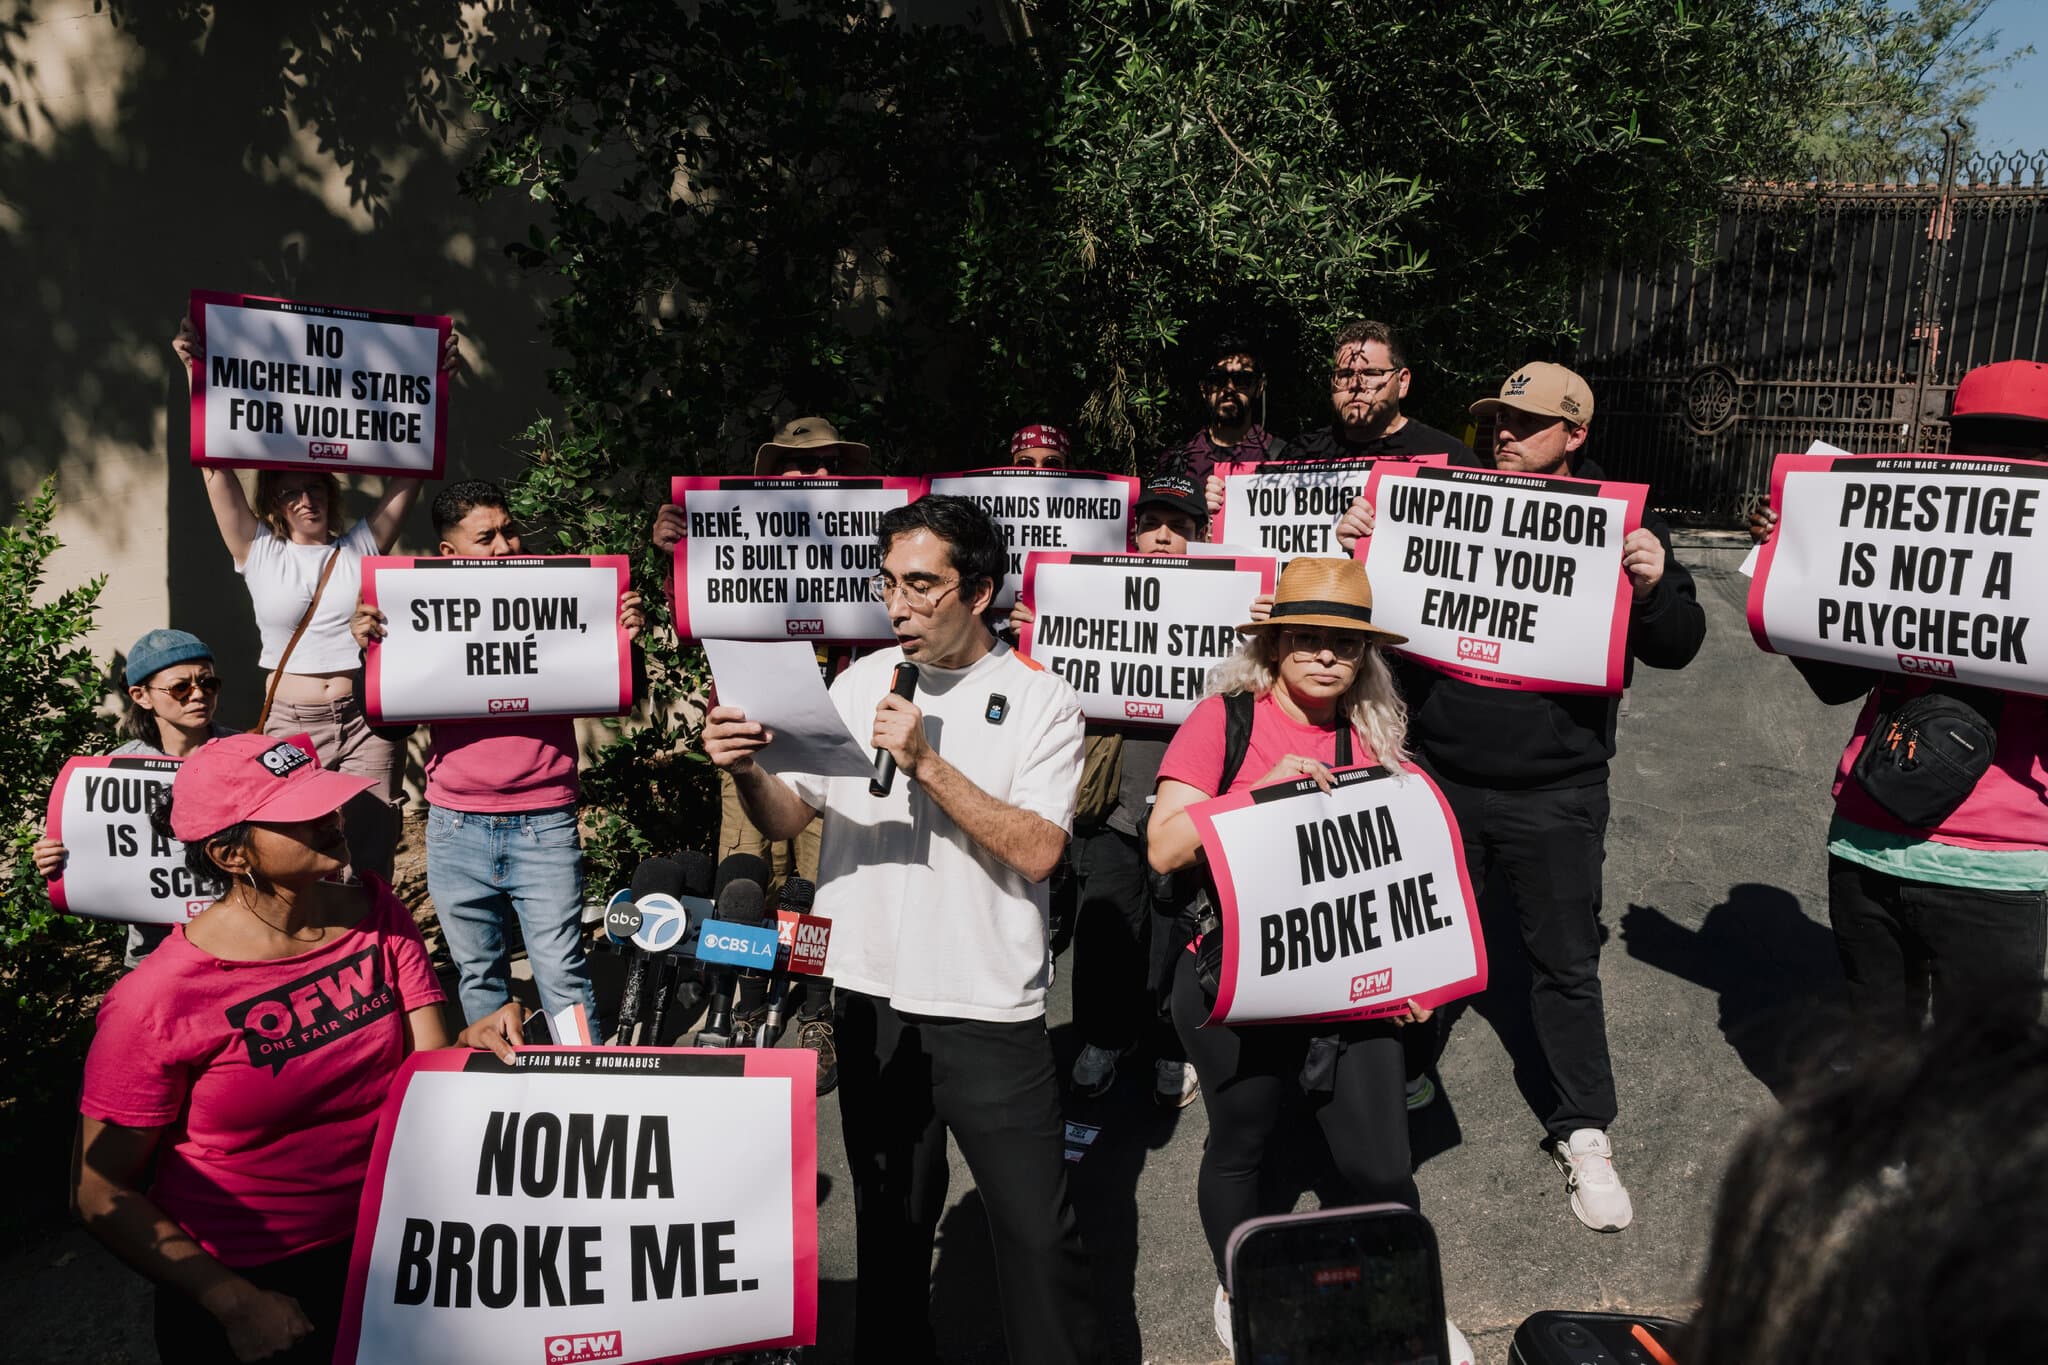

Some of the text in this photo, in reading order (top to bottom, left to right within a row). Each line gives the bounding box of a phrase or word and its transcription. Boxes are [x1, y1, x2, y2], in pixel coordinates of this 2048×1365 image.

[306, 324, 344, 359] NO
[212, 356, 431, 405] MICHELIN STARS
[230, 398, 421, 444] FOR VIOLENCE
[311, 444, 346, 455] OFW
[1876, 460, 1890, 468] ONE
[1894, 460, 1912, 469] FAIR
[1046, 497, 1121, 520] WORKED
[1246, 488, 1286, 516] YOU
[1390, 485, 1608, 548] UNPAID LABOR
[1840, 483, 2040, 537] PRESTIGE
[692, 505, 750, 540] RENÉ,
[756, 512, 810, 537] YOUR
[1021, 525, 1067, 547] FREE.
[1260, 524, 1331, 553] TICKET
[716, 545, 881, 570] IS BUILT ON OUR
[1402, 536, 1576, 597] BUILT YOUR
[1839, 542, 2012, 600] IS NOT A
[708, 578, 788, 603] BROKEN
[1125, 576, 1160, 612] NO
[410, 597, 588, 634] STEP DOWN,
[788, 621, 822, 631] OFW
[1421, 588, 1539, 644] EMPIRE
[1819, 598, 2030, 664] PAYCHECK
[1038, 616, 1158, 654] MICHELIN
[1460, 639, 1498, 656] OFW
[466, 633, 538, 676] RENÉ
[1902, 656, 1950, 672] OFW
[1051, 656, 1204, 701] FOR VIOLEN
[490, 700, 526, 710] OFW
[1127, 703, 1160, 714] OFW
[107, 824, 171, 857] IS A
[1296, 805, 1402, 886] NOMA
[609, 912, 639, 926] abc
[797, 924, 829, 945] KNX
[1260, 872, 1453, 976] BROKE ME.
[718, 936, 749, 952] CBS
[752, 942, 772, 957] LA
[794, 943, 826, 959] NEWS
[244, 954, 374, 1040] OFW
[1353, 970, 1390, 993] OFW
[260, 993, 389, 1055] ONE FAIR WAGE
[529, 1056, 550, 1066] FAIR
[554, 1056, 581, 1067] WAGE
[596, 1057, 661, 1068] #NOMAABUSE
[476, 1111, 674, 1200] NOMA
[394, 1218, 759, 1309] BROKE ME.
[549, 1334, 616, 1356] OFW
